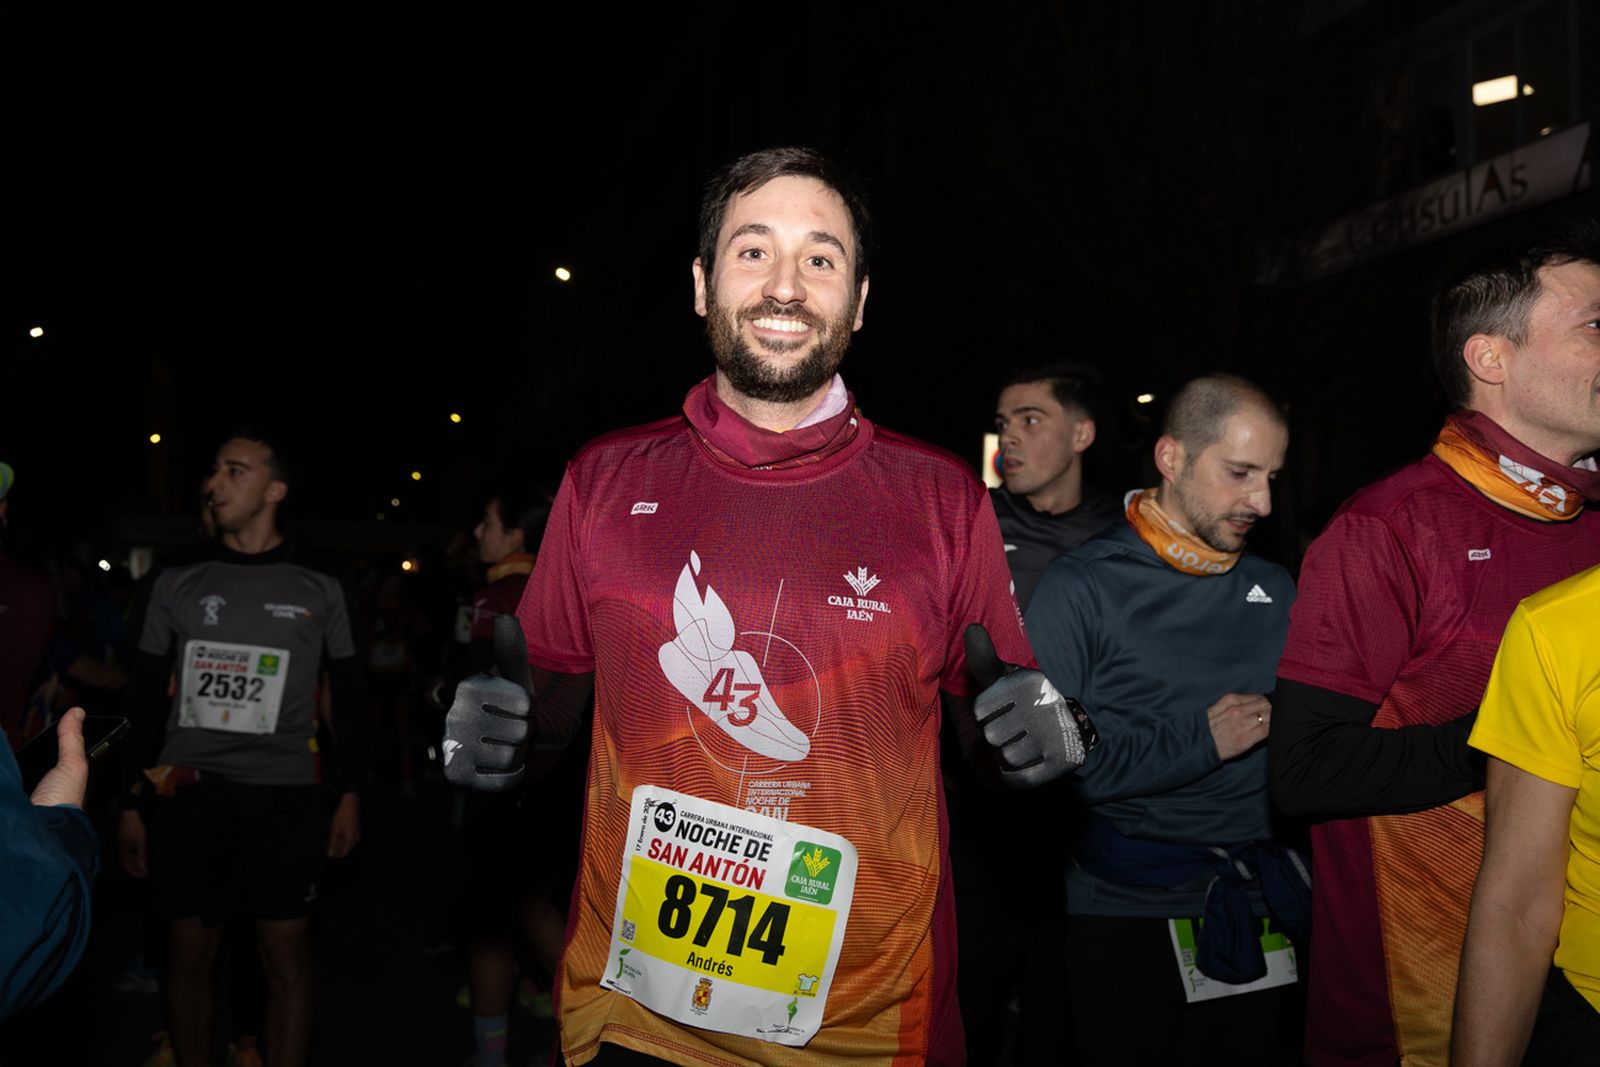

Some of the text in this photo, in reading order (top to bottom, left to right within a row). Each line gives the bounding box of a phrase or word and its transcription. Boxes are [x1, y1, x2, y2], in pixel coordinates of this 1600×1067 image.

[1167, 543, 1231, 575] erón
[827, 595, 892, 613] CAJA RURAL
[847, 609, 874, 622] JAÉN
[197, 672, 265, 702] 2532
[702, 667, 761, 727] 43
[746, 797, 791, 806] NOCHE DE
[655, 808, 675, 826] 43
[680, 811, 774, 842] CARRERA URBANA INTERNACIONAL
[675, 819, 773, 862] NOCHE DE
[647, 838, 767, 891] SAN ANTÓN
[791, 874, 830, 891] CAJA RURAL
[800, 885, 818, 896] JAÉN
[657, 874, 791, 966] 8714
[686, 950, 734, 977] Andrés
